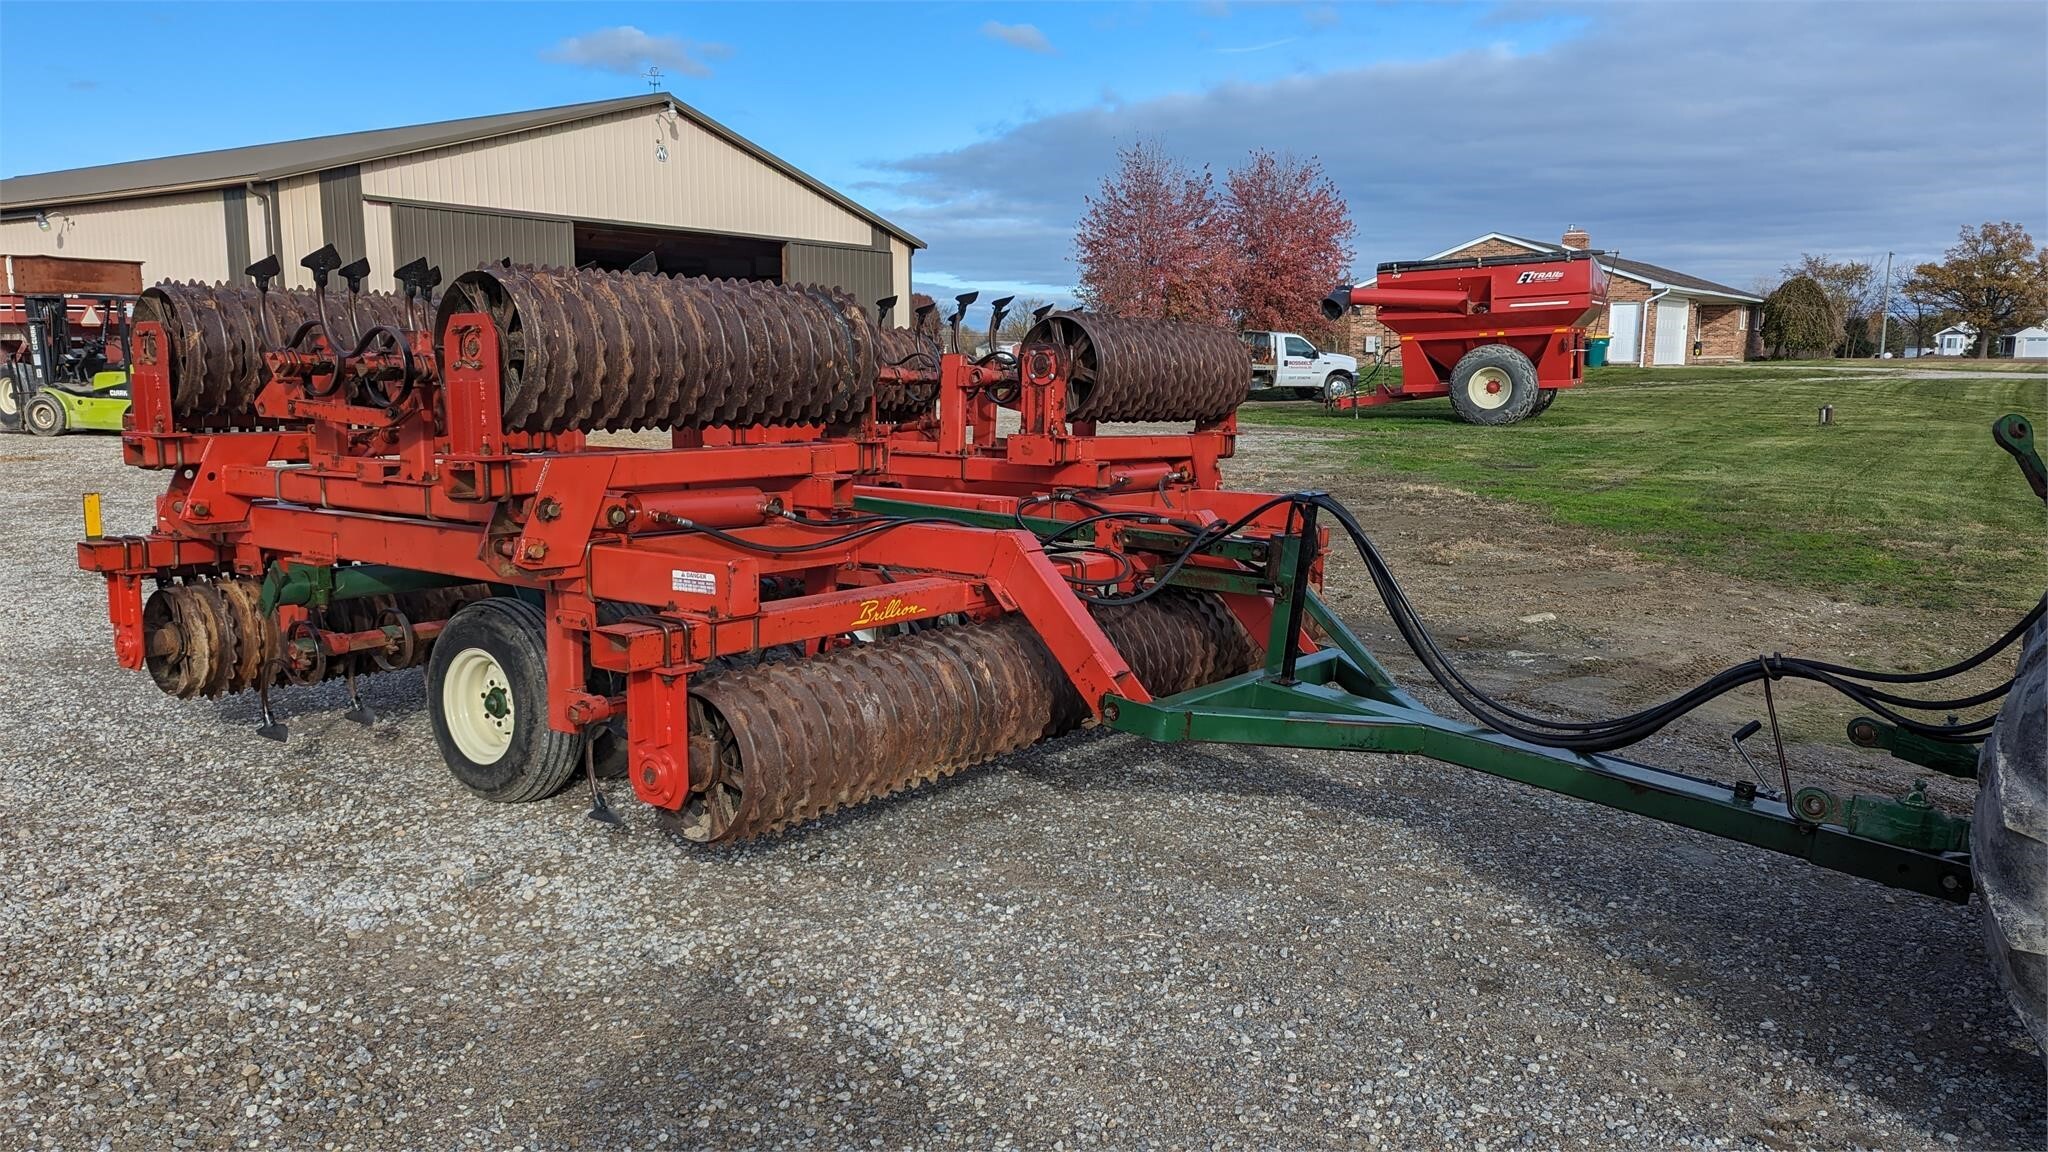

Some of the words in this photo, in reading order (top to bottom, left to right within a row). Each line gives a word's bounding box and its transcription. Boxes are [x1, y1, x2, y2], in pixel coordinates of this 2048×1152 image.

[109, 389, 128, 397] CLARK
[686, 572, 707, 580] DANGER
[851, 599, 927, 626] Brillion
